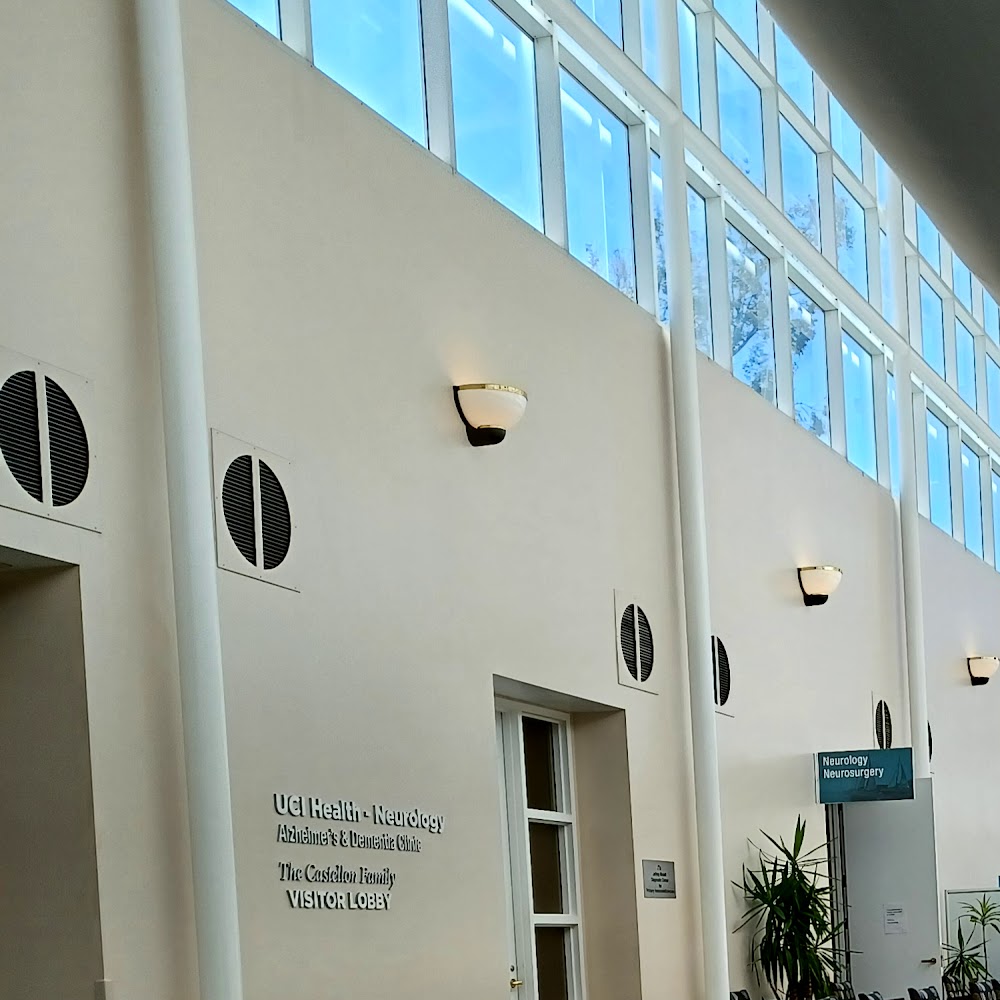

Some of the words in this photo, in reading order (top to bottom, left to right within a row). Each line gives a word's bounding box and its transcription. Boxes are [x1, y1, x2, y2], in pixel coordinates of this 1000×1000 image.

[822, 755, 868, 766] Neurology
[823, 767, 884, 778] Neurosurgery
[273, 793, 306, 817] UCI
[308, 797, 361, 823] Health
[372, 804, 445, 835] Neurology
[277, 824, 339, 847] Alzheimer's
[340, 829, 350, 848] &
[350, 830, 396, 851] Dementia
[396, 833, 422, 853] Clinic
[278, 861, 303, 881] The
[304, 863, 357, 883] Castellon
[359, 866, 396, 891] Family
[286, 889, 346, 910] VISITOR
[347, 891, 392, 911] LOBBY
